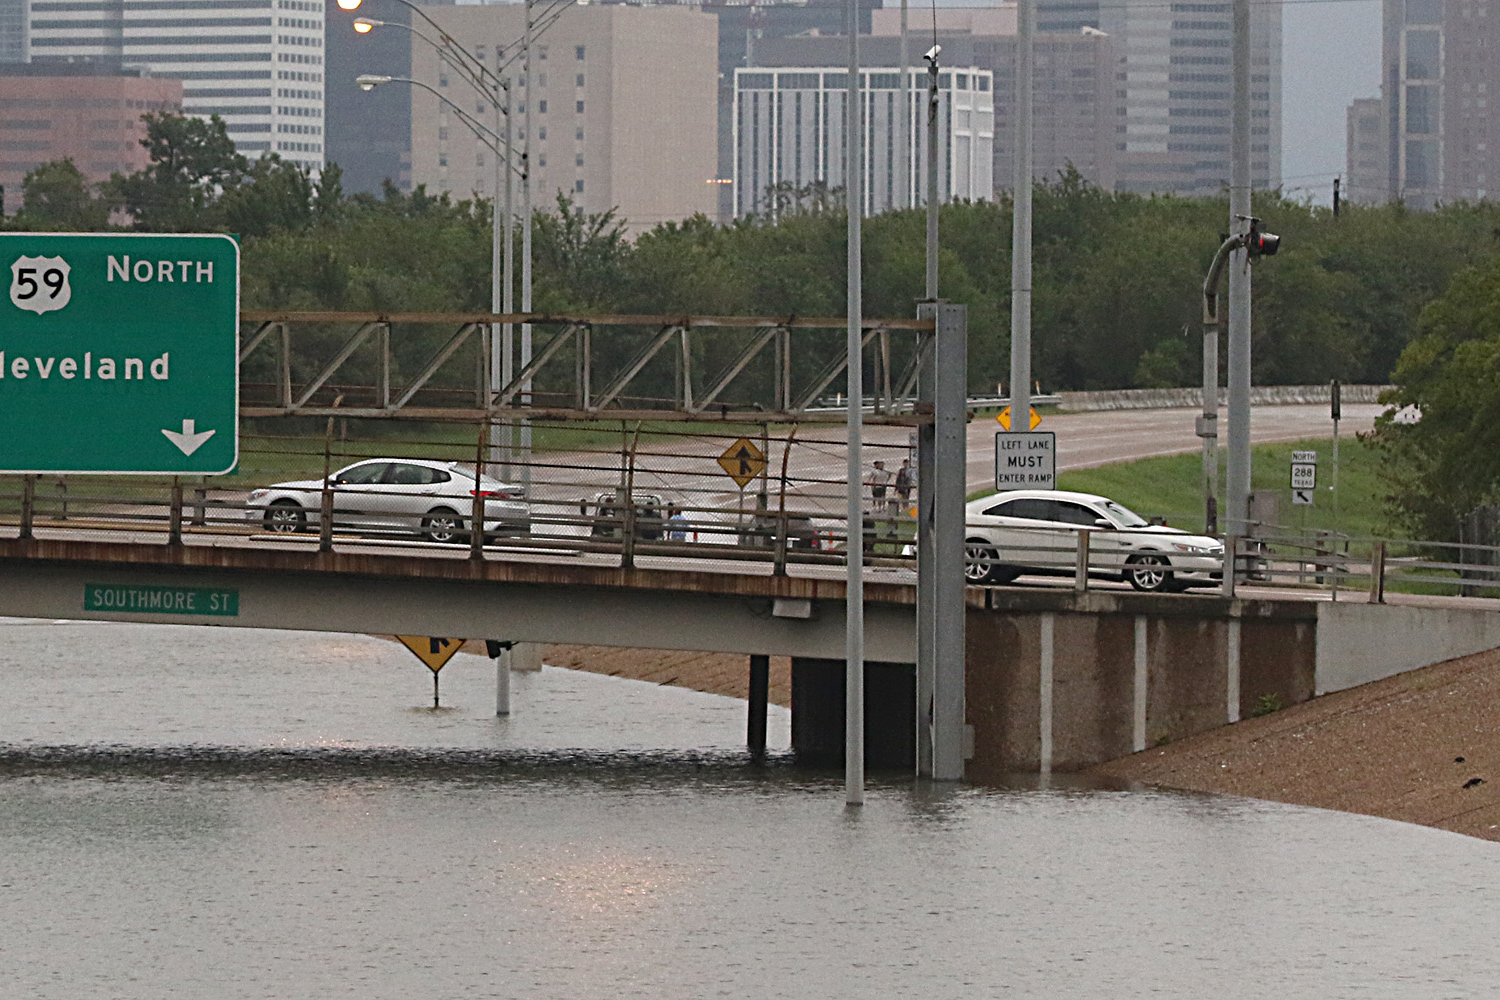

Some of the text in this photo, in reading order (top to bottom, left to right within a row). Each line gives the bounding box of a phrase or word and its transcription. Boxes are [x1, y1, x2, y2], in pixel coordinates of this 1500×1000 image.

[106, 255, 214, 284] NORTH
[17, 268, 65, 300] 59
[1001, 440, 1049, 450] LEFT LANE
[1007, 456, 1043, 468] MUST
[1292, 453, 1315, 461] NORTH
[1294, 468, 1313, 477] 288
[999, 474, 1052, 483] ENTER RAMP
[93, 589, 230, 611] SOUTHMORE ST
